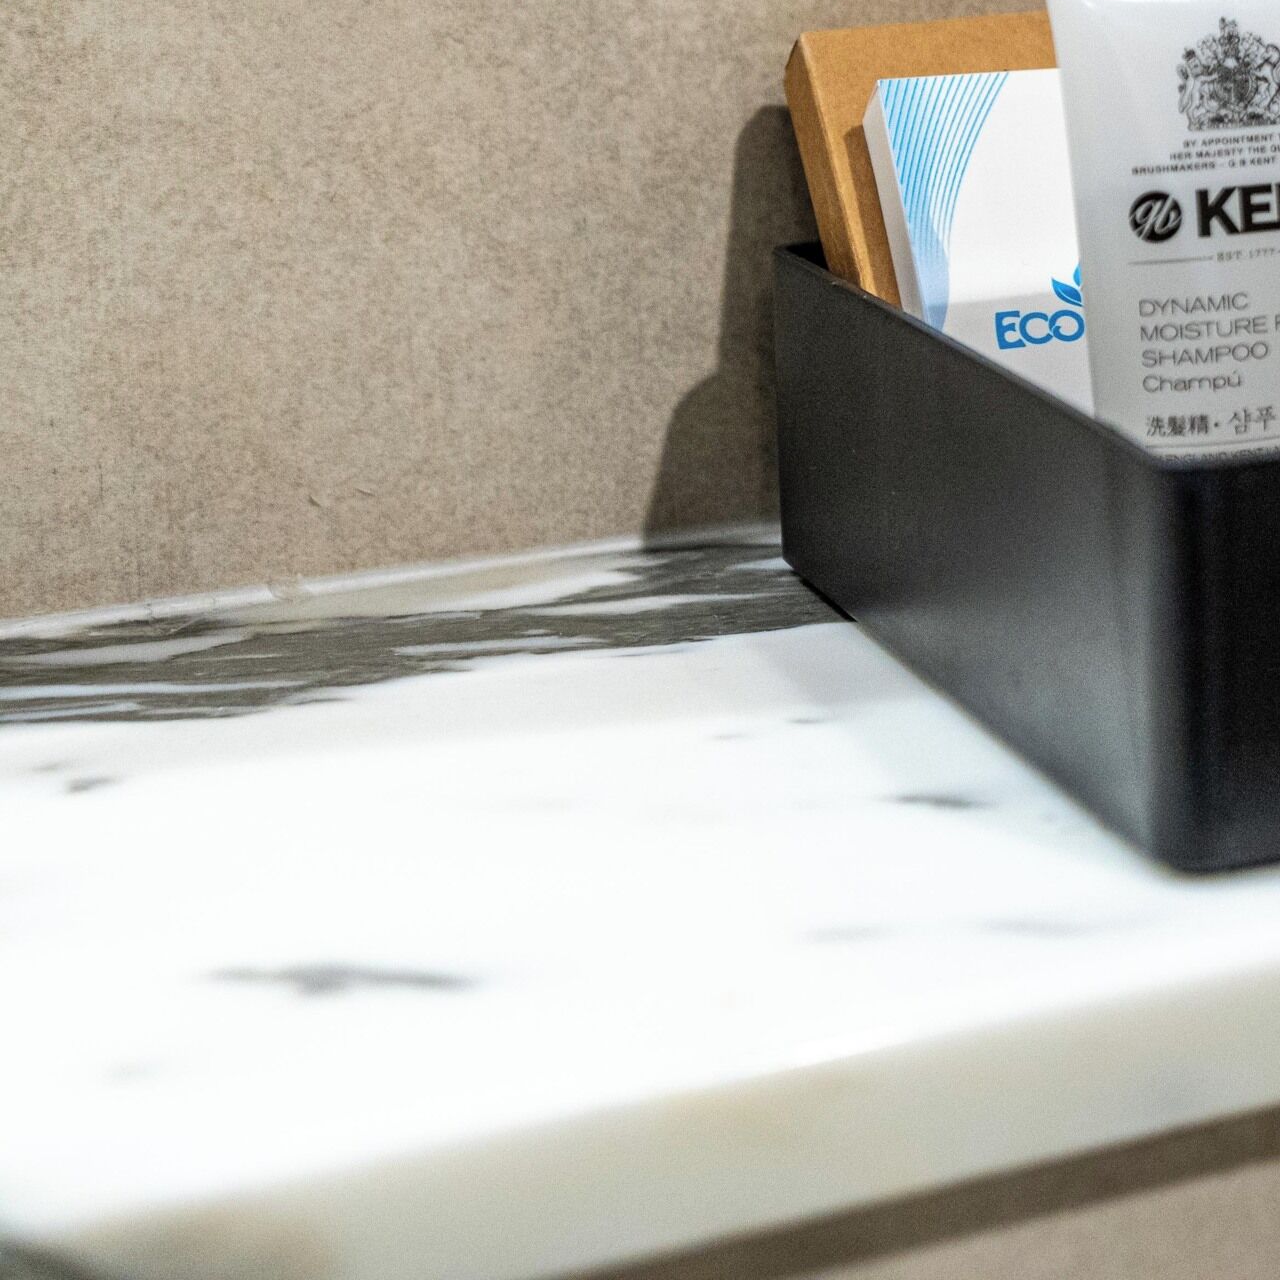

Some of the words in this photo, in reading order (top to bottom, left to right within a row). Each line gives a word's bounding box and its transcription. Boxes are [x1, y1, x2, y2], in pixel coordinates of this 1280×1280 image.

[1169, 151, 1192, 161] HER
[1195, 148, 1243, 159] MAJESTY
[1247, 145, 1267, 155] THE
[1201, 134, 1273, 148] APPOINTMENT
[1131, 161, 1216, 176] BRUSHMAKERS
[1250, 155, 1276, 167] KENT
[1138, 292, 1249, 317] DYNAMIC
[994, 308, 1085, 350] ECO
[1140, 315, 1269, 342] MOISTURE
[1141, 340, 1269, 368] SHAMPOO
[1142, 370, 1241, 393] Champú
